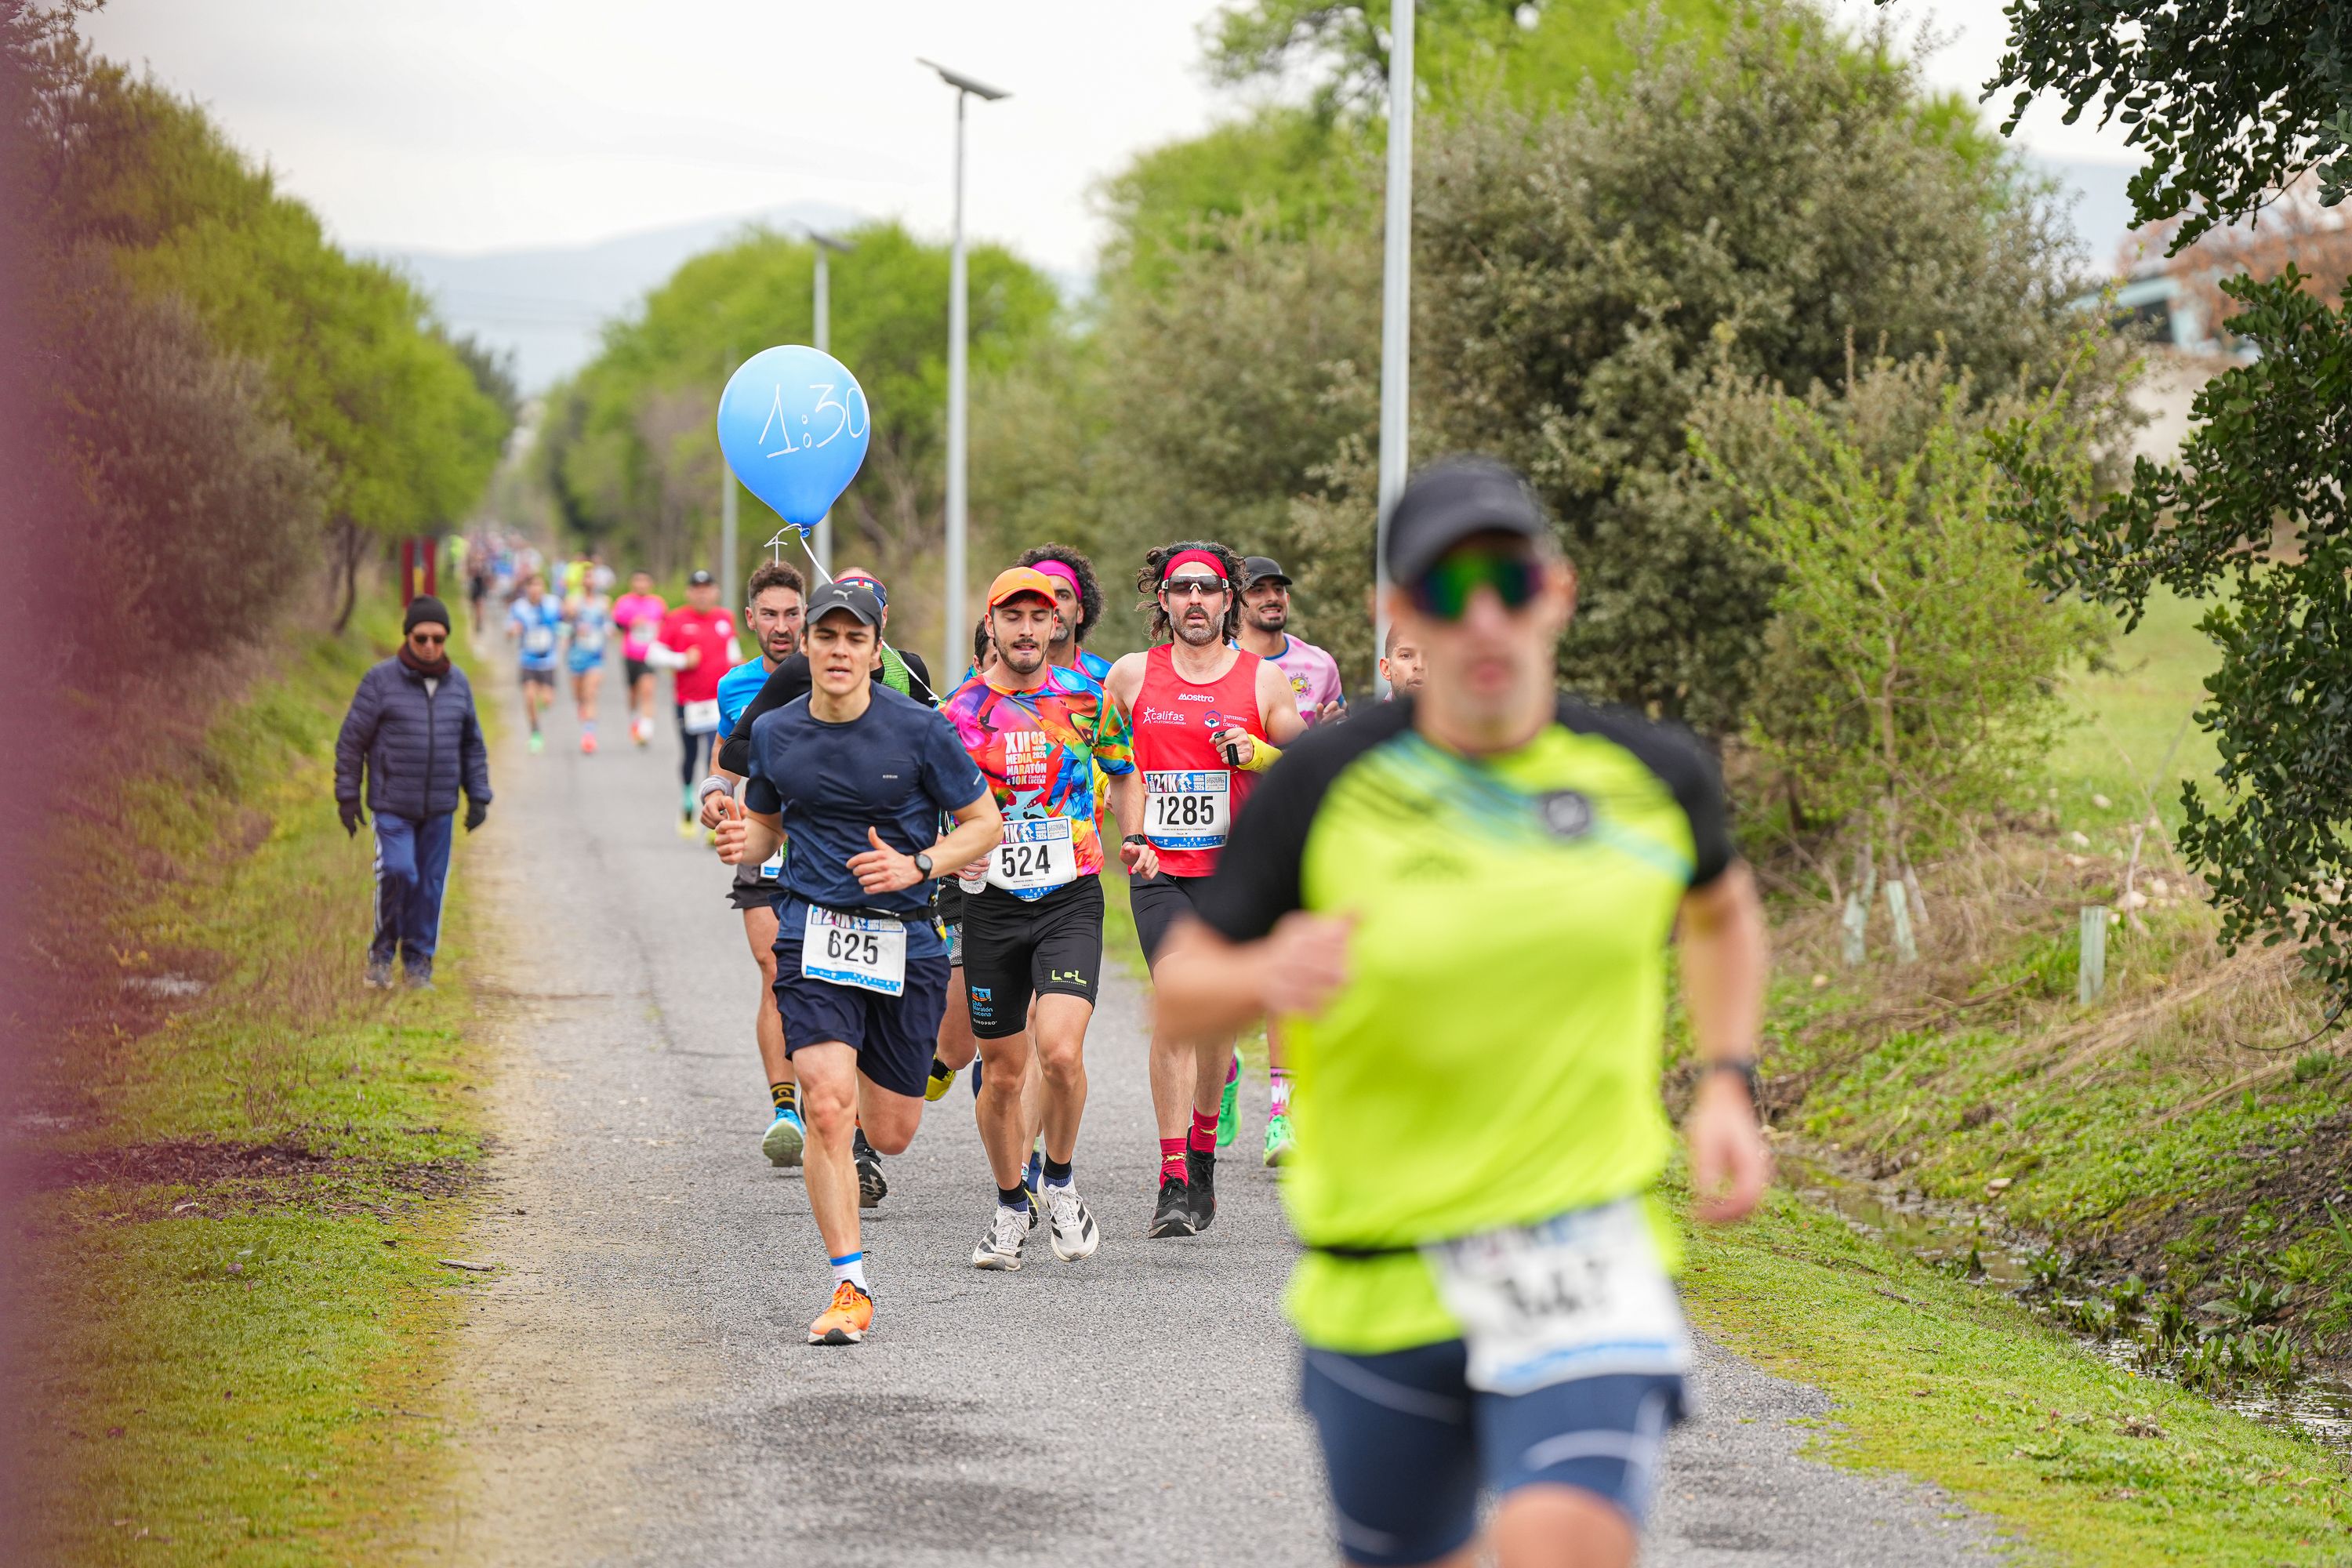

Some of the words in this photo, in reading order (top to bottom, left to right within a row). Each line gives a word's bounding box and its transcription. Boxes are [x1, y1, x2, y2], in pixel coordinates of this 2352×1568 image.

[758, 383, 867, 459] 1:30
[1151, 710, 1185, 721] califas
[1004, 731, 1031, 754] XII
[1031, 731, 1047, 745] 08
[1005, 752, 1033, 765] MEDIA
[1006, 760, 1047, 776] MARATÓN
[1011, 775, 1028, 785] 10K
[1156, 795, 1214, 826] 1285
[1004, 823, 1020, 844] 1K
[1001, 844, 1051, 878] 524
[827, 929, 878, 965] 625
